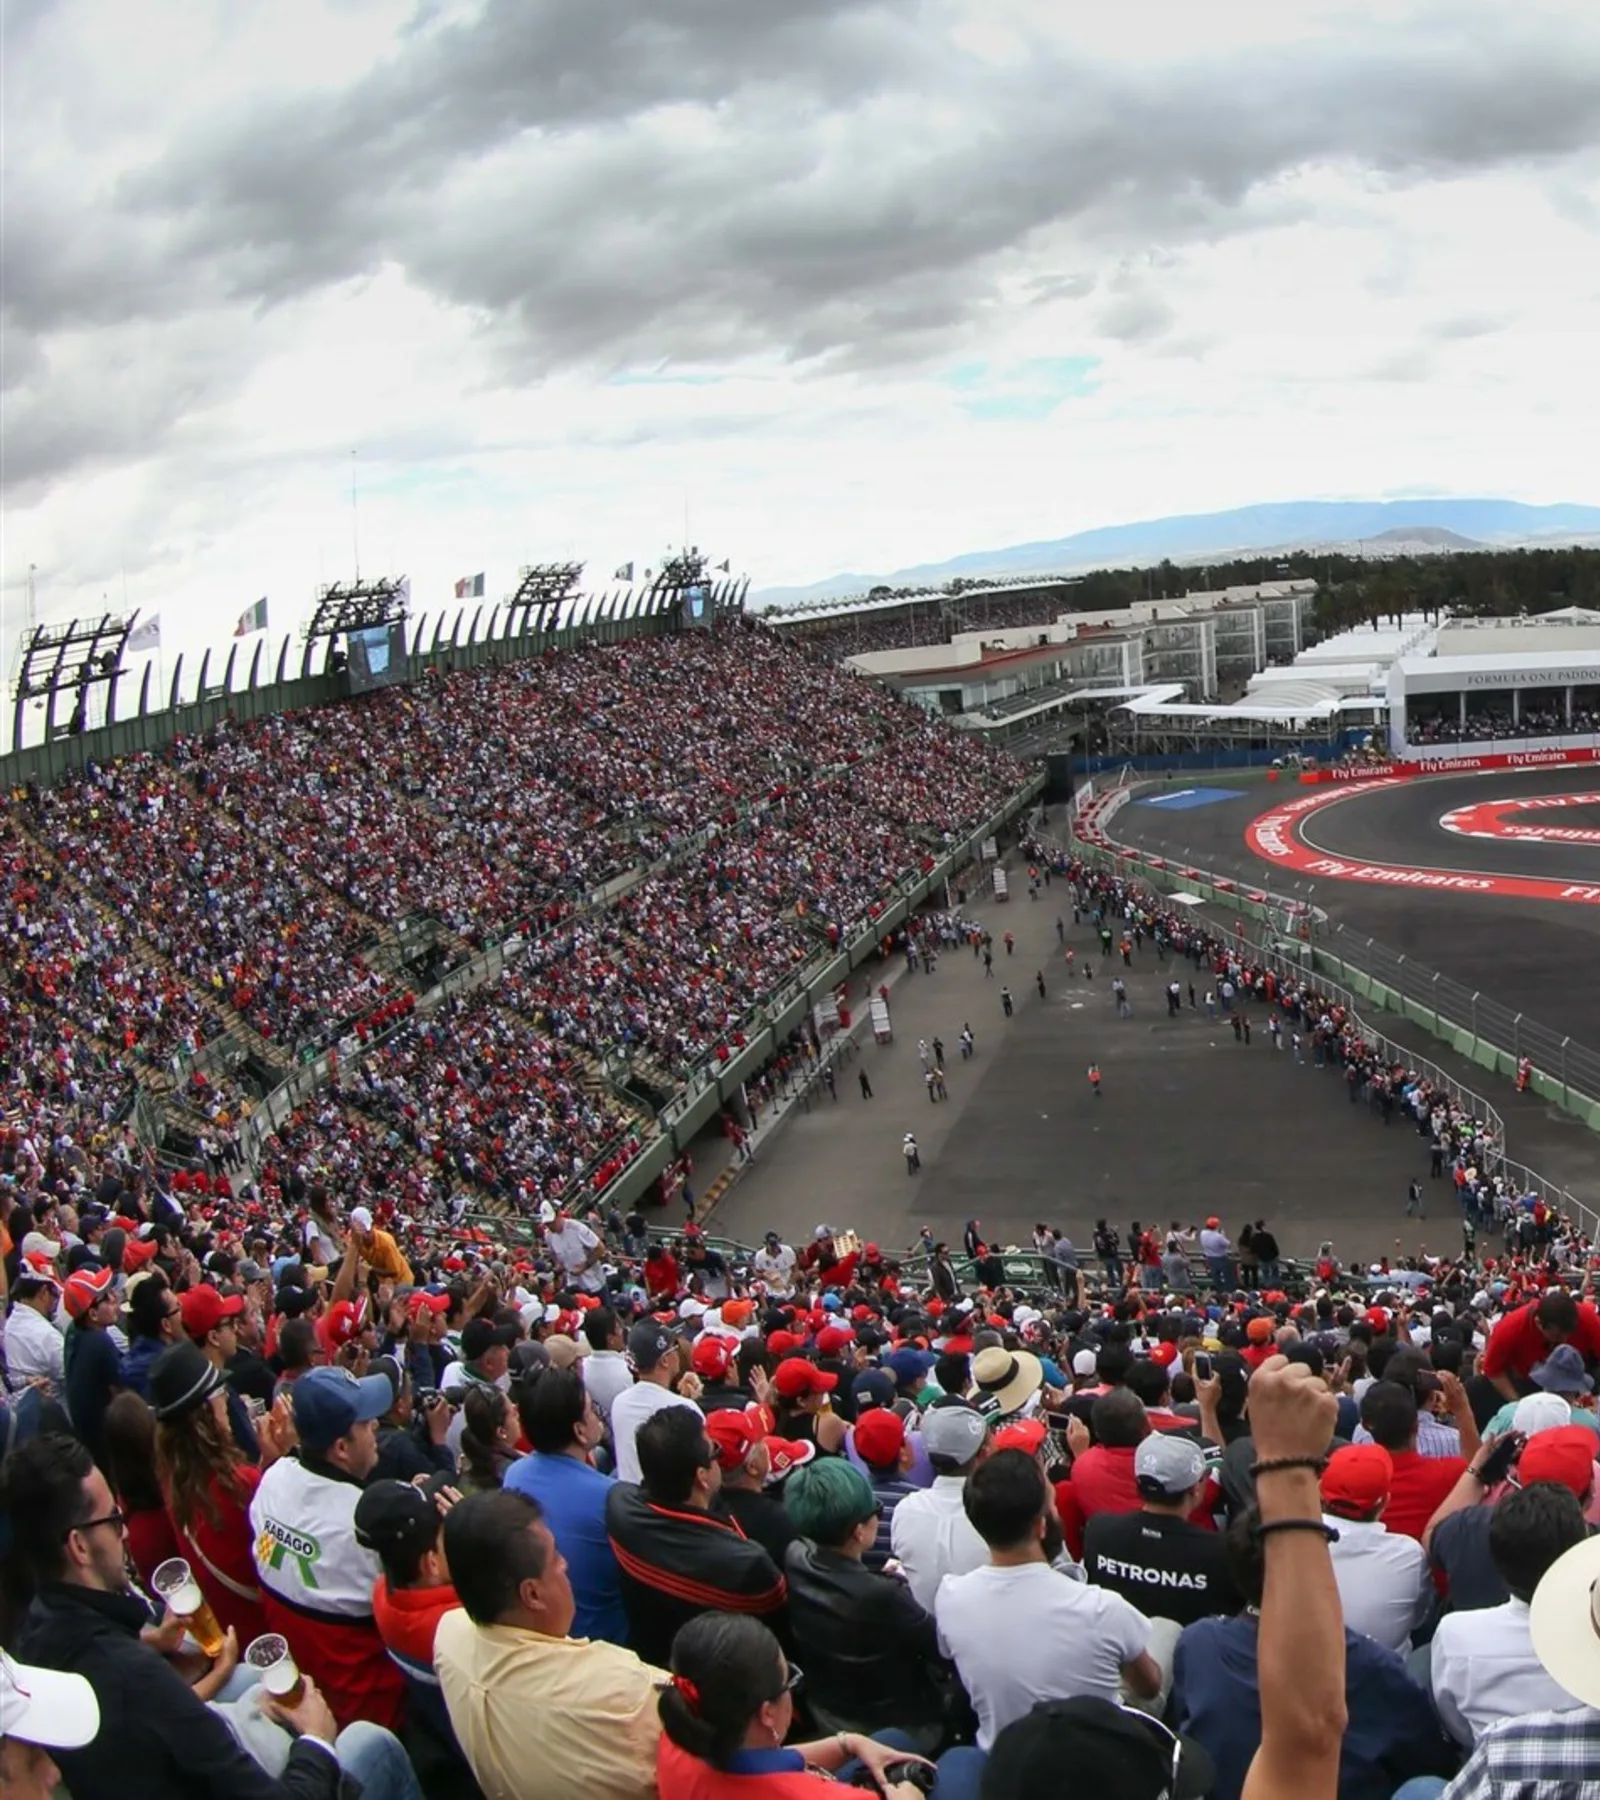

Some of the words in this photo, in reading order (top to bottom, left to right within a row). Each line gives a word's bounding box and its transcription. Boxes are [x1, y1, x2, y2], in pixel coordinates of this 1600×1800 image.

[1467, 673, 1526, 684] FORMULA
[1529, 671, 1552, 682] ONE
[1420, 762, 1437, 772] Fly
[1438, 758, 1480, 771] Emirates
[1507, 754, 1524, 765] Fly
[1525, 751, 1566, 763] Emirates
[1331, 770, 1350, 780] Fly
[1350, 765, 1394, 778] Emirates
[1515, 798, 1568, 809] Fly
[1305, 858, 1356, 877] Fly
[1352, 864, 1496, 891] Emirates
[264, 1519, 314, 1556] RABAGO
[1097, 1553, 1208, 1590] PETRONAS
